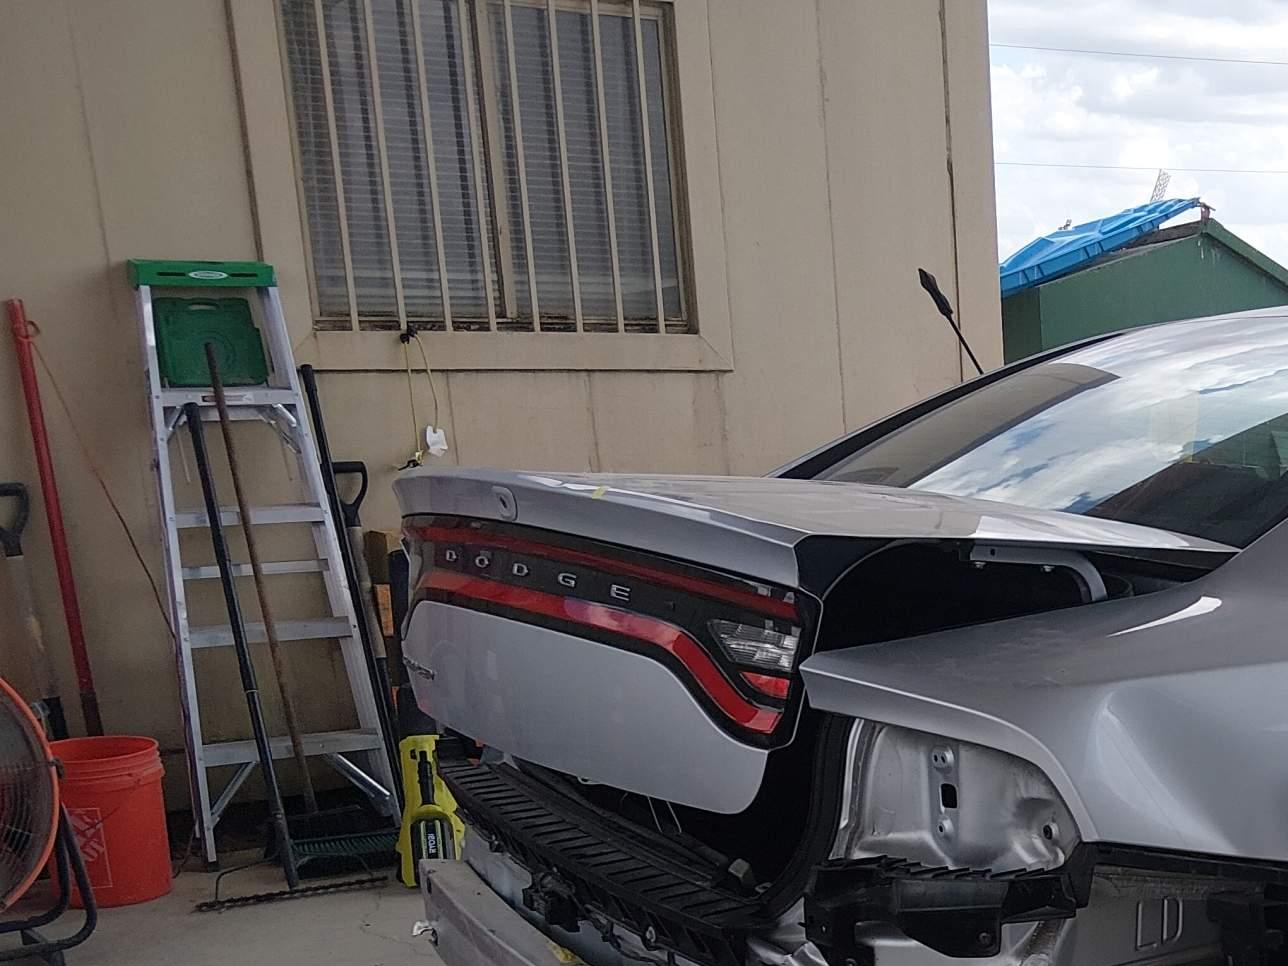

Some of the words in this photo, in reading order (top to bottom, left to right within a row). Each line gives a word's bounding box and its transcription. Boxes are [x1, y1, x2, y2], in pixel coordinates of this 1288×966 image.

[445, 549, 631, 602] DODGE
[427, 833, 437, 854] RYOBI
[1135, 895, 1184, 951] LD
